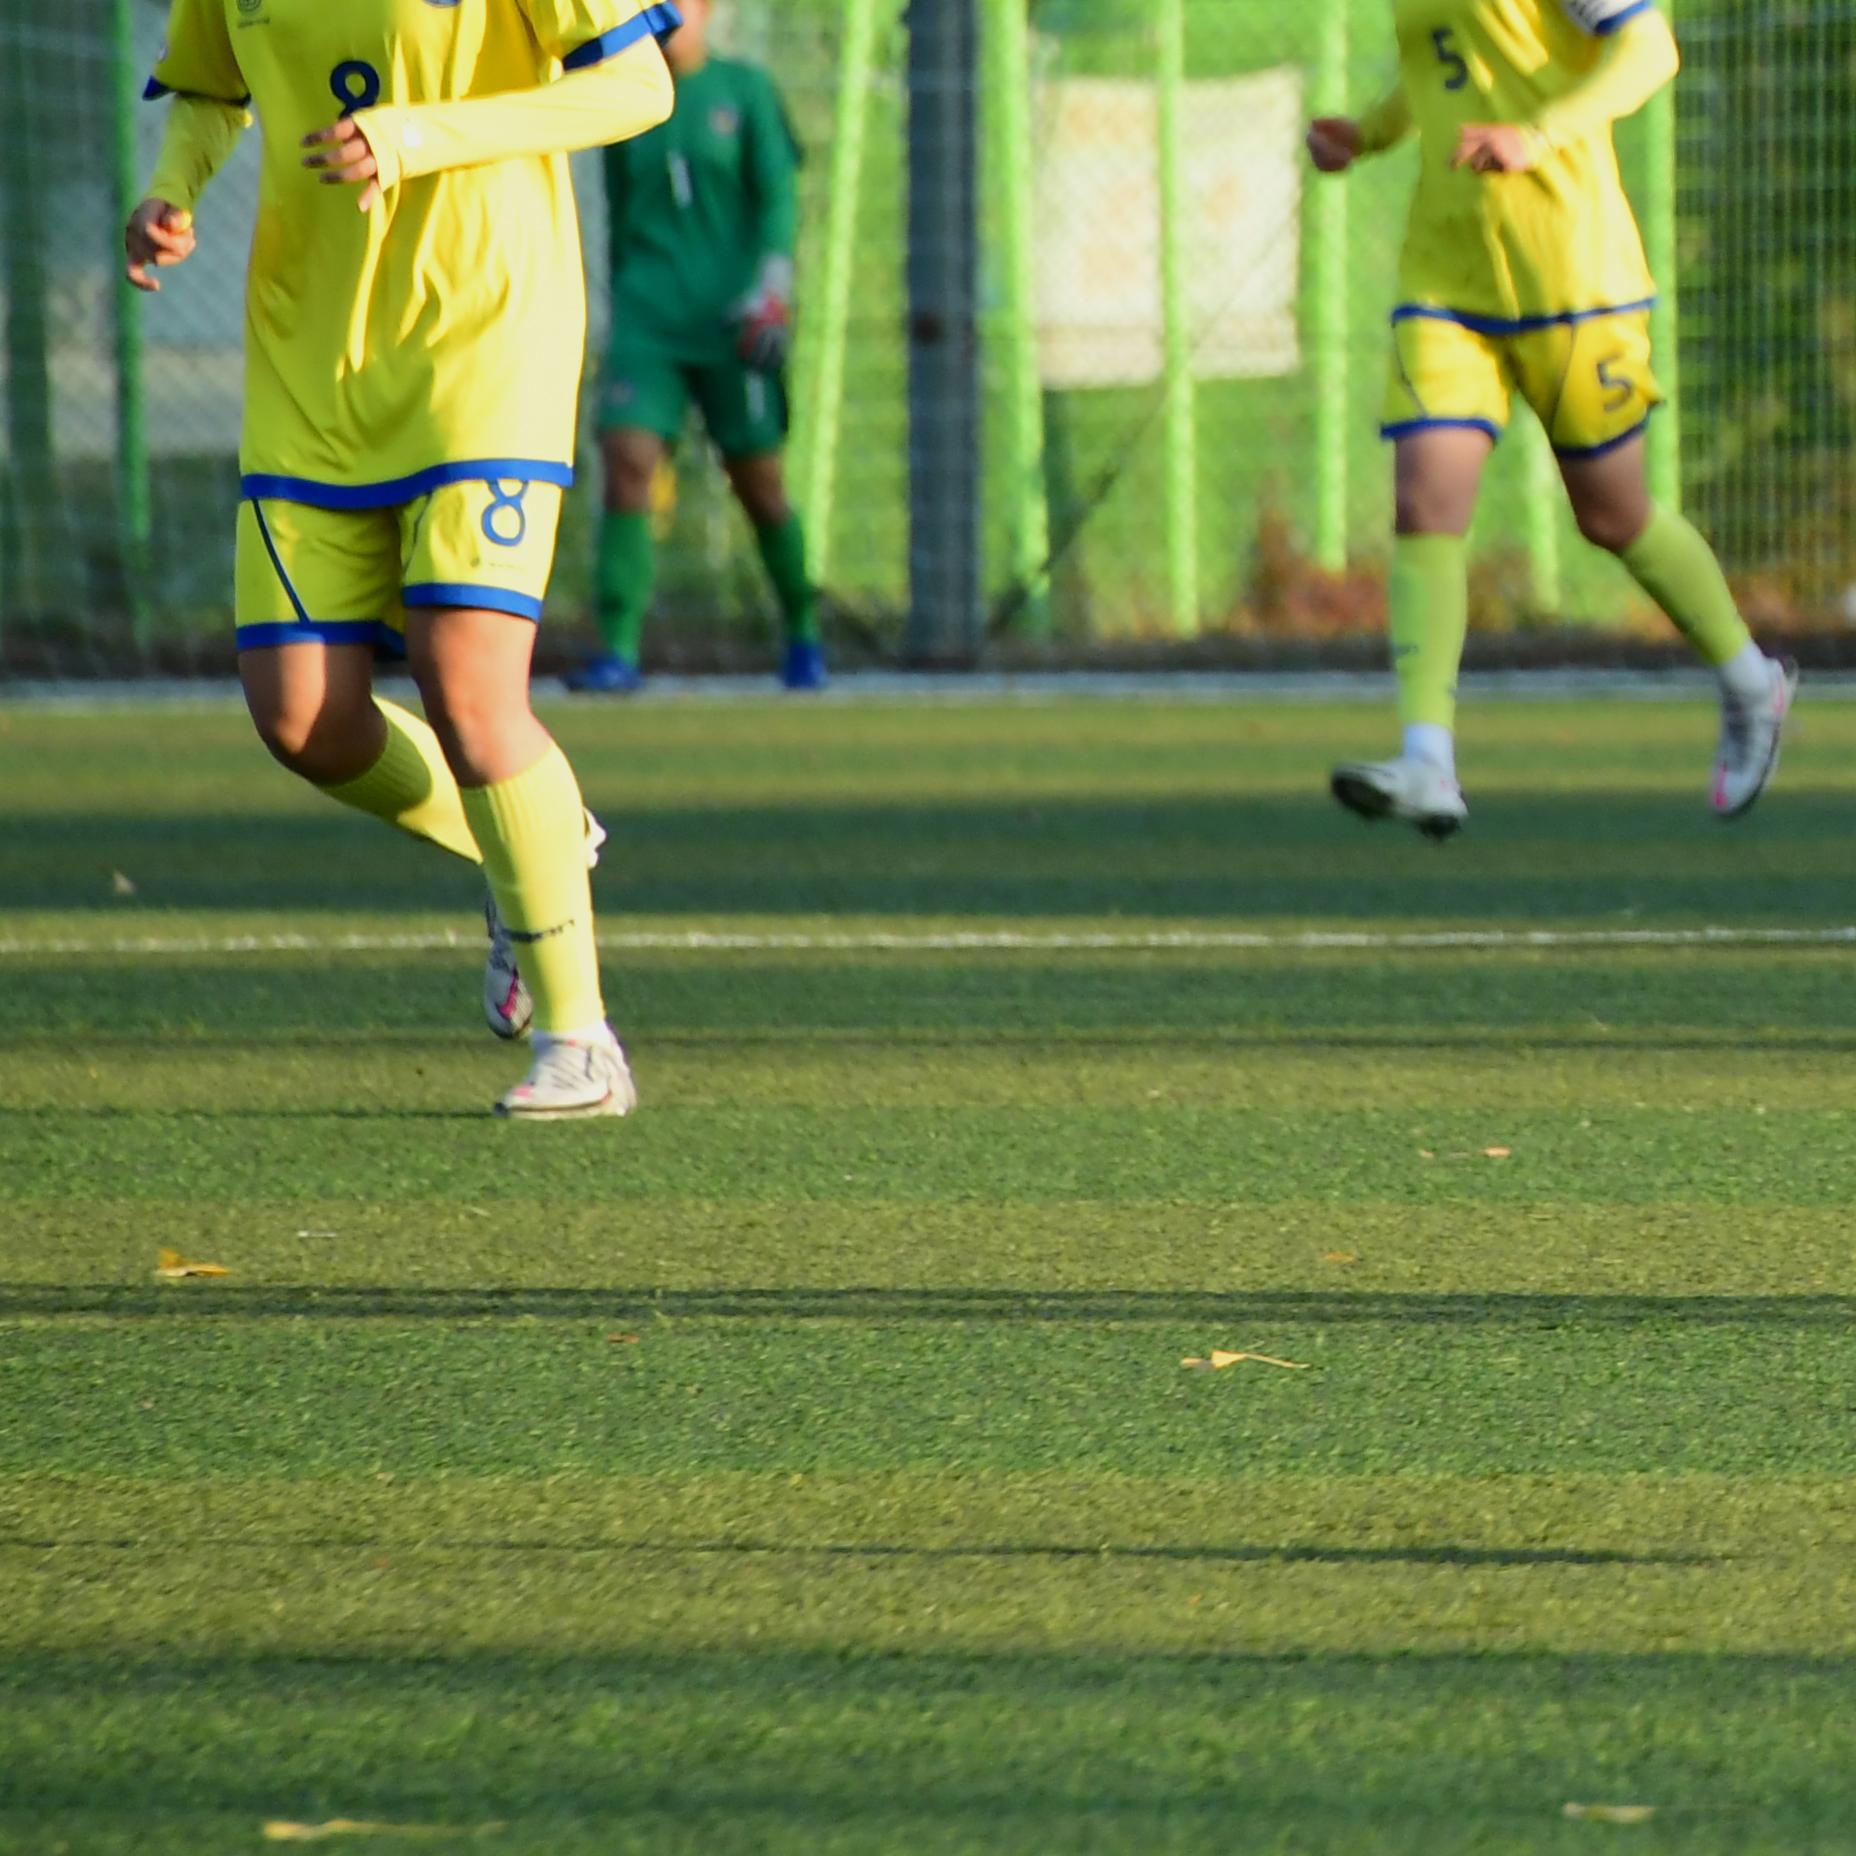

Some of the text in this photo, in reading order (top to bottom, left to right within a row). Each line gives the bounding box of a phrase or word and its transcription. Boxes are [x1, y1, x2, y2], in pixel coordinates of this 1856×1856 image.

[1431, 27, 1469, 90] 5
[1595, 355, 1634, 413] 5
[481, 479, 529, 547] 8
